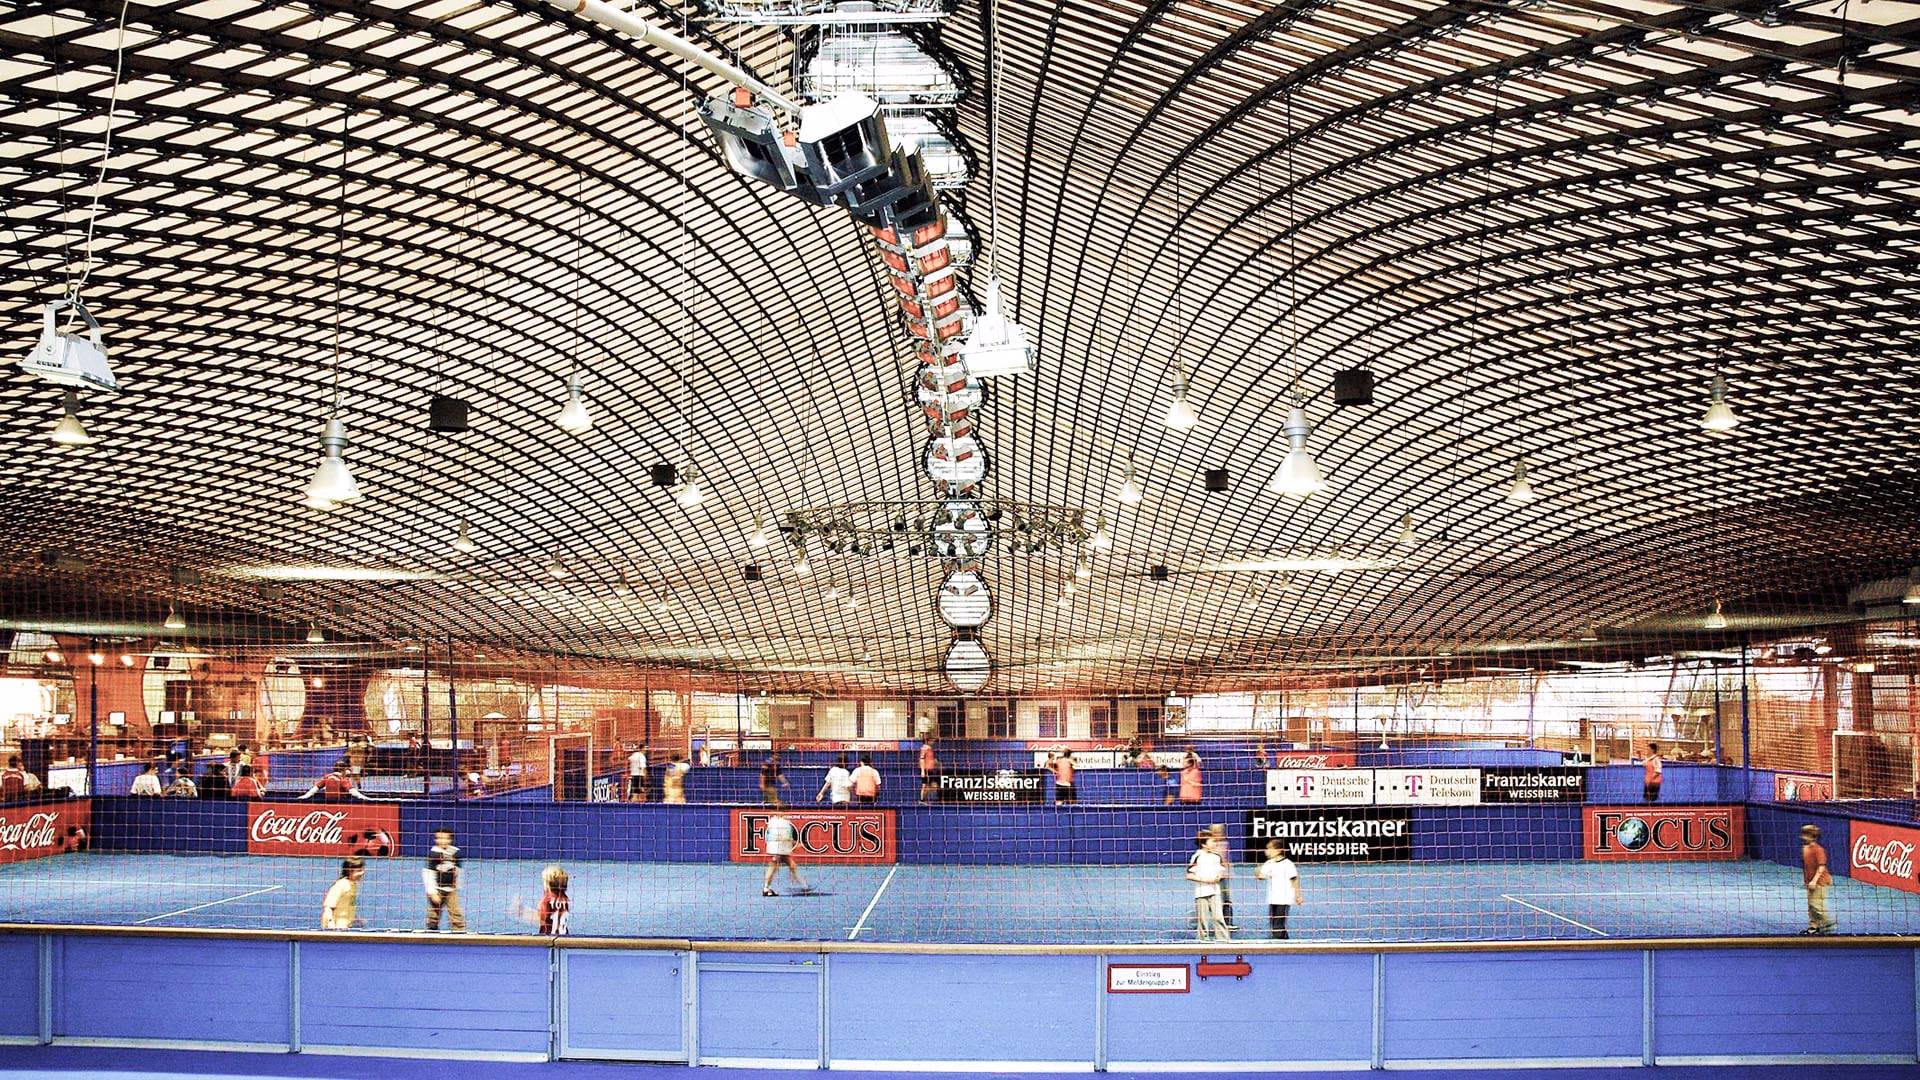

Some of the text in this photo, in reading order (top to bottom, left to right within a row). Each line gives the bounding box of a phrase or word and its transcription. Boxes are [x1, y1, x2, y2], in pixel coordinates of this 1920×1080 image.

[940, 775, 1040, 789] Franziskaner
[1322, 775, 1370, 786] Deutsche
[1429, 775, 1477, 786] Deutsche
[1486, 773, 1583, 788] Franziskaner
[963, 791, 1016, 801] WEISSBIER
[1321, 788, 1364, 798] Telekom
[1429, 787, 1473, 798] Telekom
[1508, 789, 1560, 799] WEISSBIER
[0, 812, 59, 850] oca-Cola
[251, 809, 348, 844] Coca-Cola
[1252, 816, 1406, 838] Franziskaner
[1595, 812, 1731, 852] FOCUS
[1289, 842, 1370, 855] WEISSBIER
[1852, 834, 1917, 880] Coca-Cola
